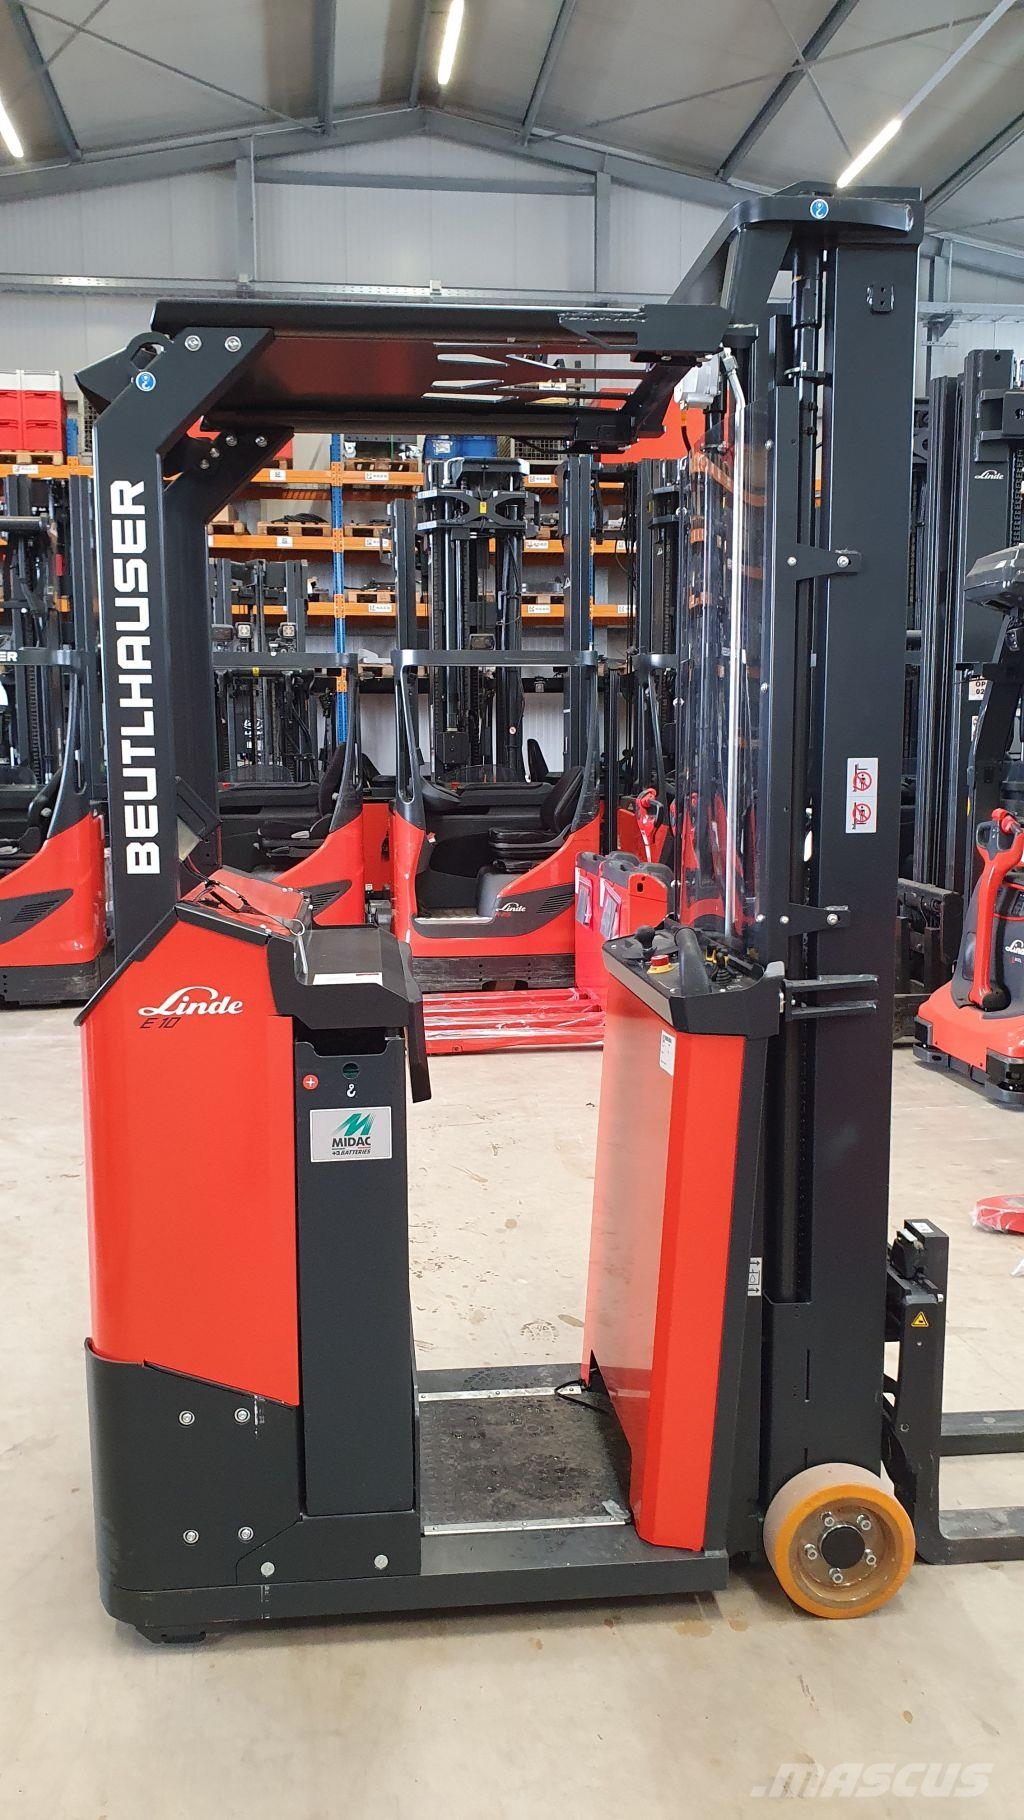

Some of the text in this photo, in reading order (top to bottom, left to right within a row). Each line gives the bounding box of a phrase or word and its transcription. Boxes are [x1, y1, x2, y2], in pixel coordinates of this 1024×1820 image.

[974, 469, 1004, 480] Linde
[110, 479, 161, 875] BEUTLHAUSER
[495, 902, 527, 912] Linde
[138, 985, 244, 1016] Linde
[140, 1016, 182, 1029] E 10
[331, 1136, 372, 1148] MIDAC
